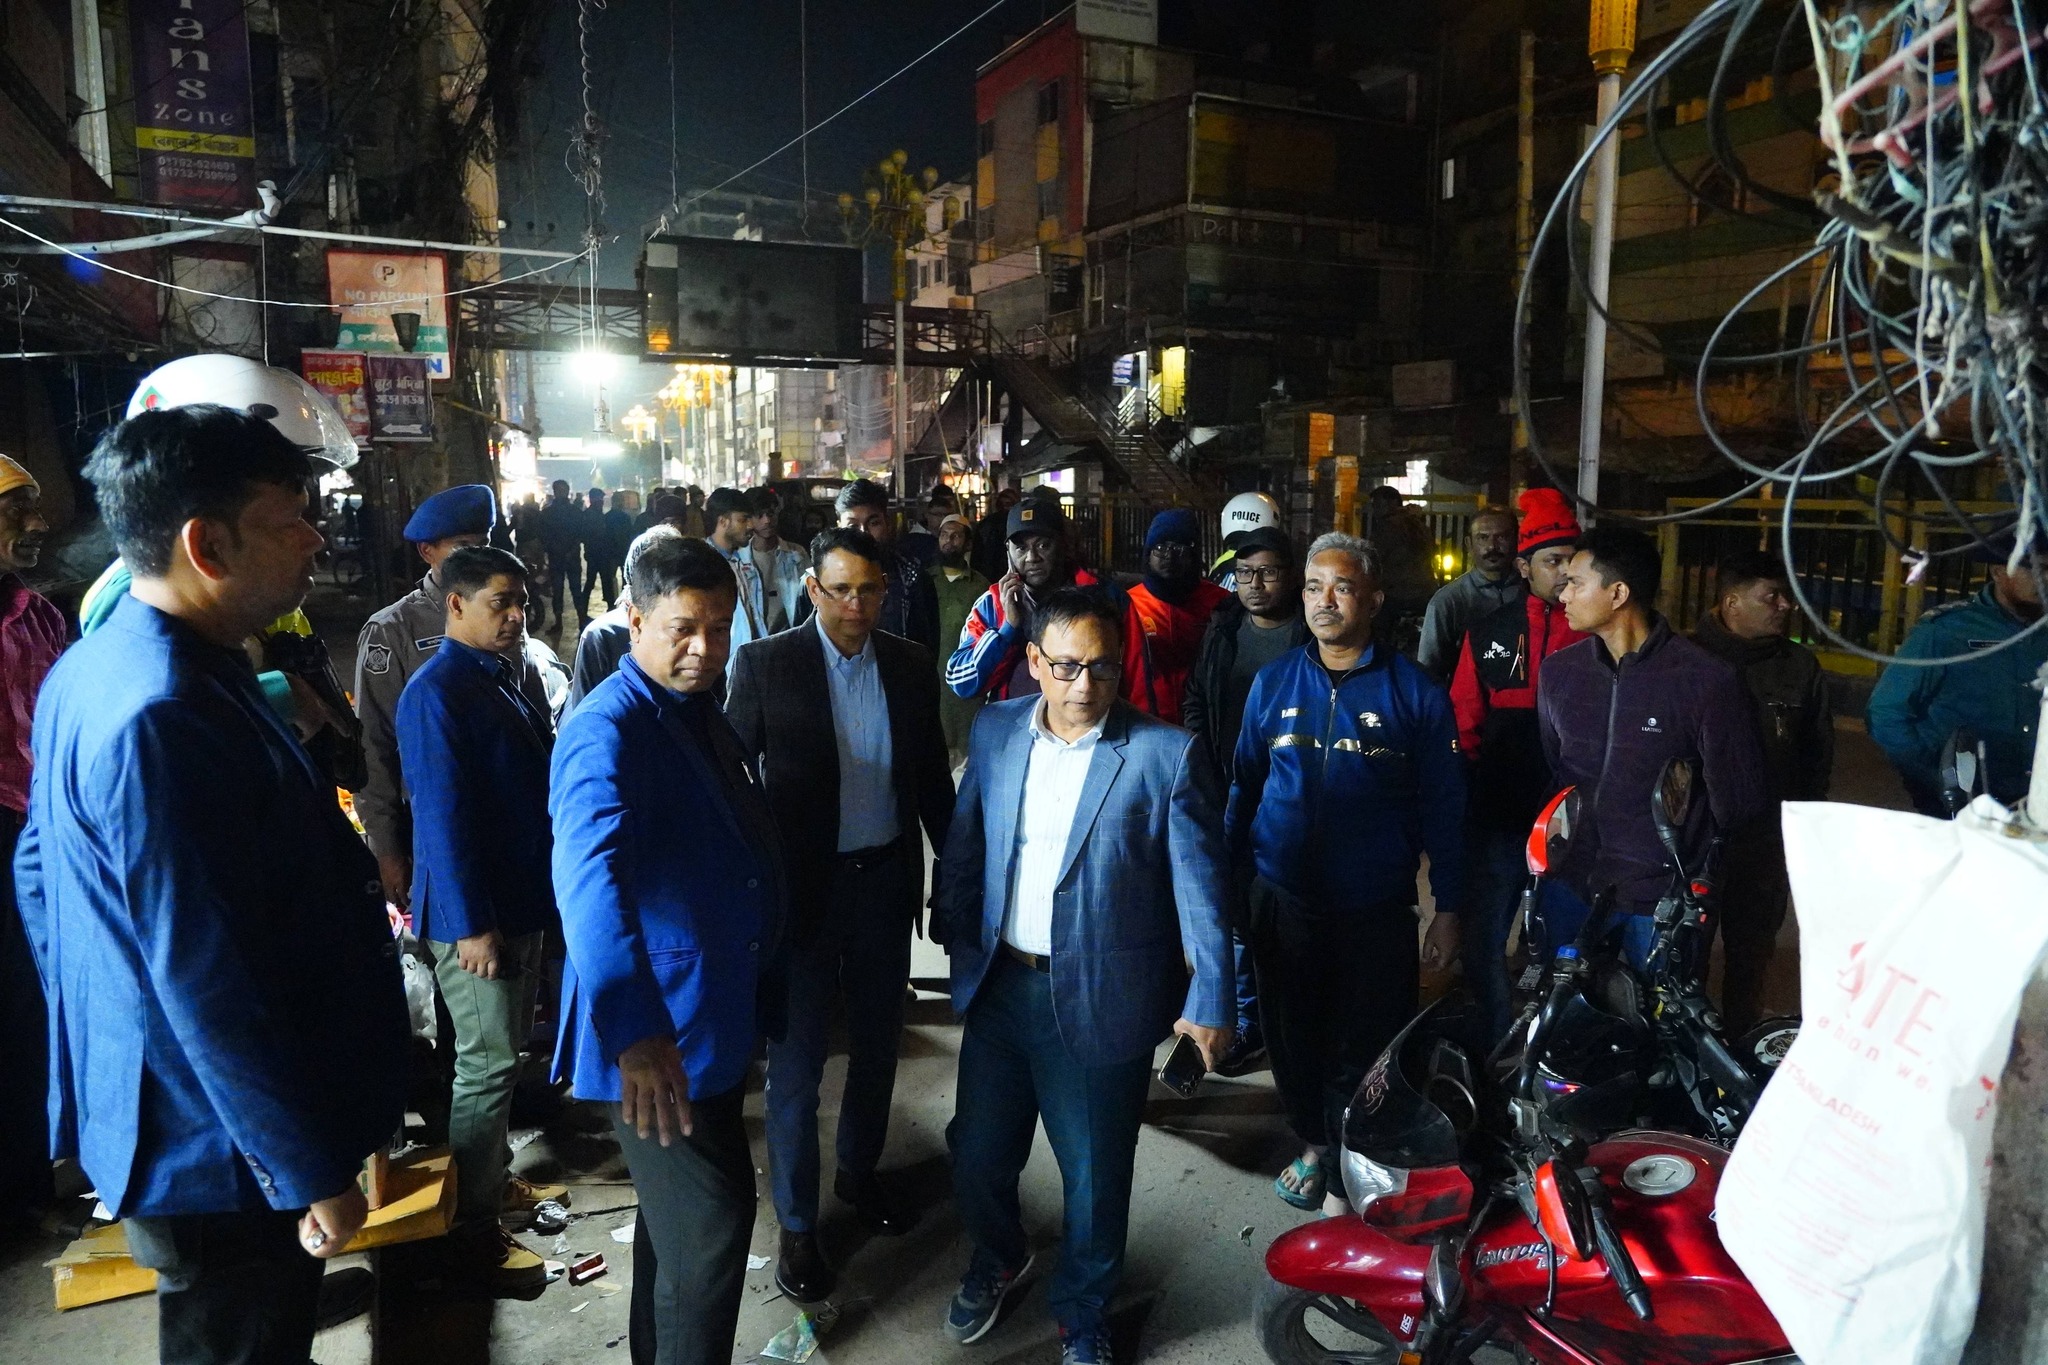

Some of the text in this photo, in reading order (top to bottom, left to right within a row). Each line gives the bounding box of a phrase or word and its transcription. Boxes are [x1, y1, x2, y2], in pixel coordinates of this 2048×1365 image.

[344, 289, 366, 301] NO
[1231, 510, 1261, 524] POLICE
[1482, 649, 1496, 660] SK
